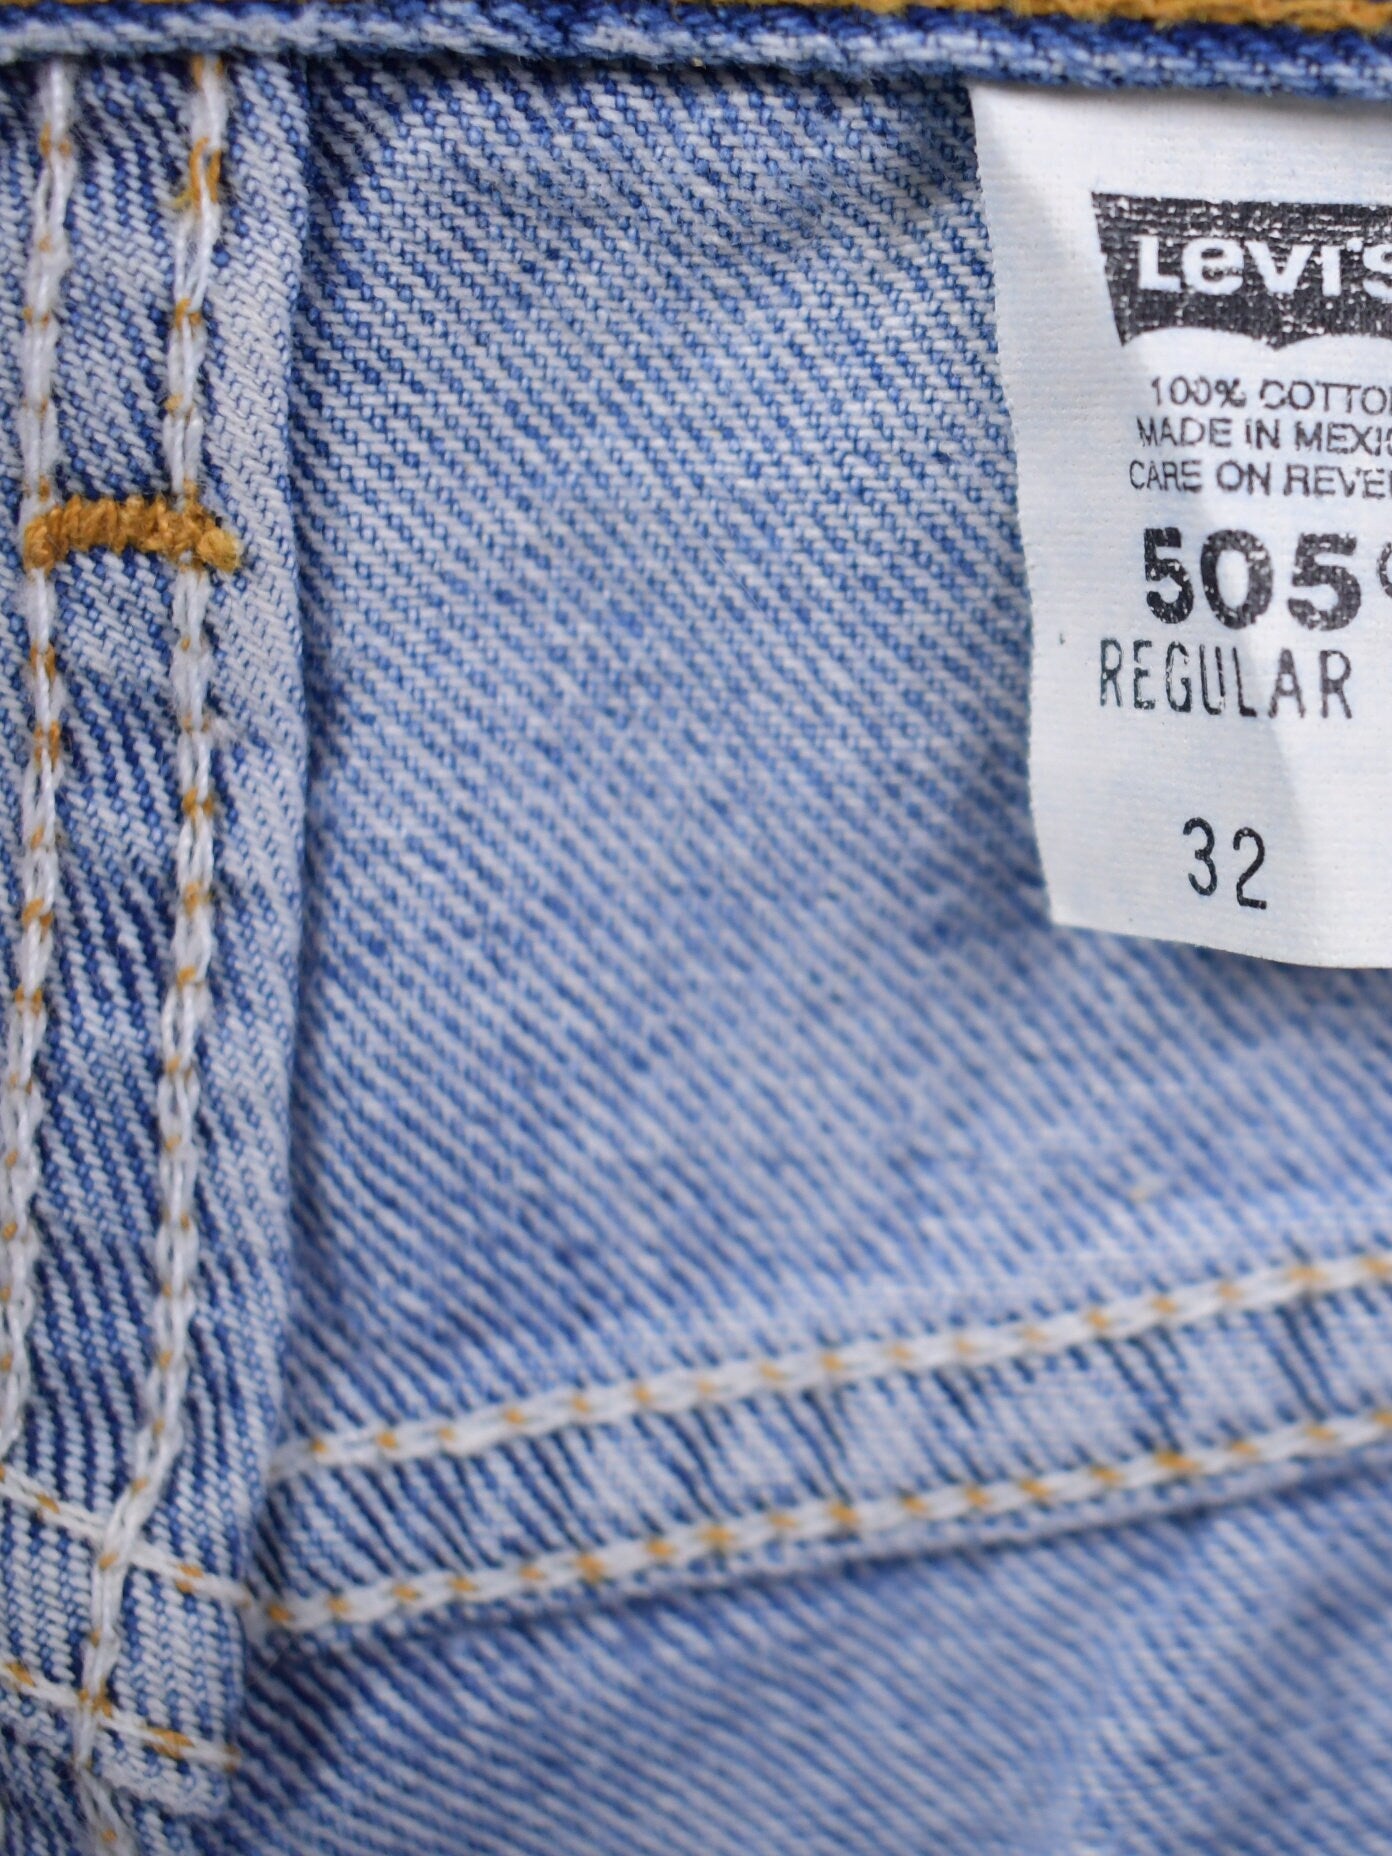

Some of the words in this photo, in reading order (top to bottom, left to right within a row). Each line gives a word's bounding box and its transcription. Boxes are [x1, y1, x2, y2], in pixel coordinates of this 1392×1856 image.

[1150, 376, 1246, 408] 100%
[1136, 417, 1232, 449] MADE
[1245, 418, 1280, 451] IN
[1128, 459, 1202, 492] CARE
[1215, 460, 1272, 495] ON
[1100, 637, 1353, 720] REGULAR
[1182, 816, 1268, 911] 32
